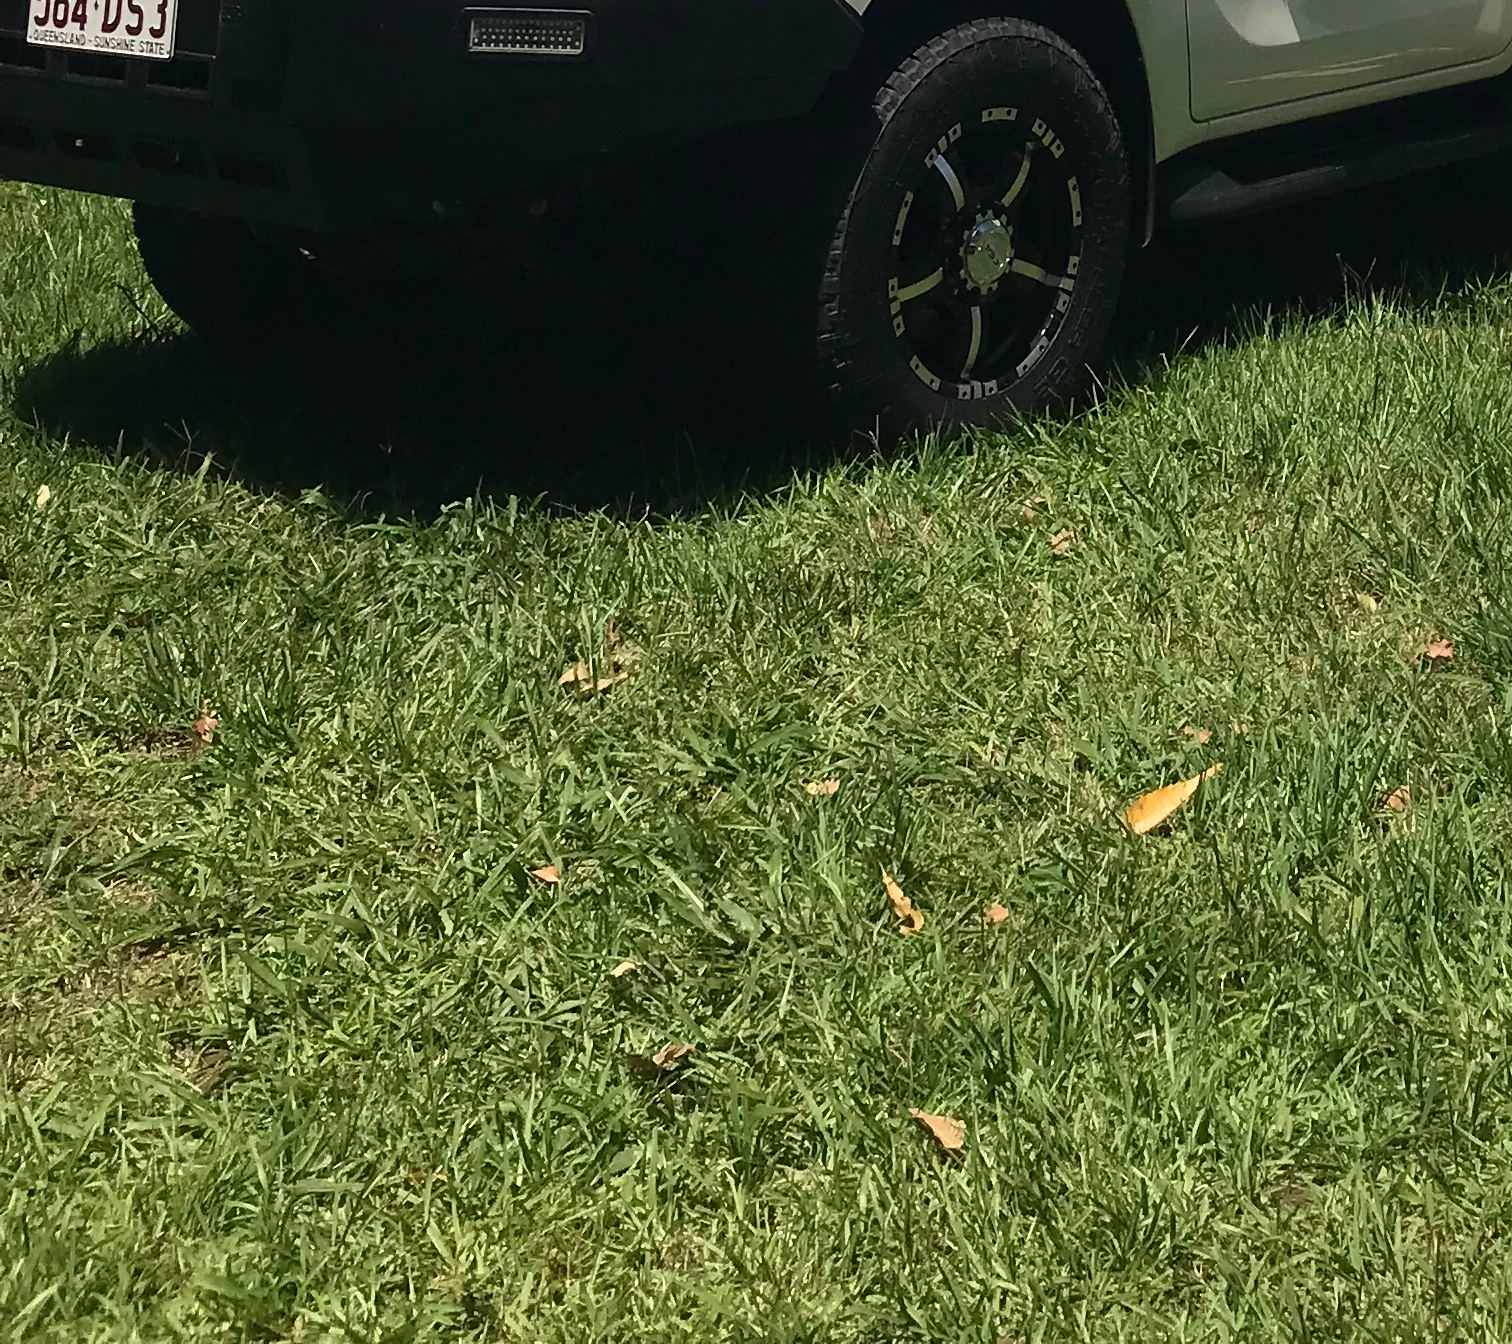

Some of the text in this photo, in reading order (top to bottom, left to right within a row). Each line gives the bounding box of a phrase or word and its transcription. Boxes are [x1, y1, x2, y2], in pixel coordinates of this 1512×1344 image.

[33, 28, 87, 47] QUEENSLAND
[94, 36, 136, 53] SUNSHINE
[138, 40, 165, 56] STATE
